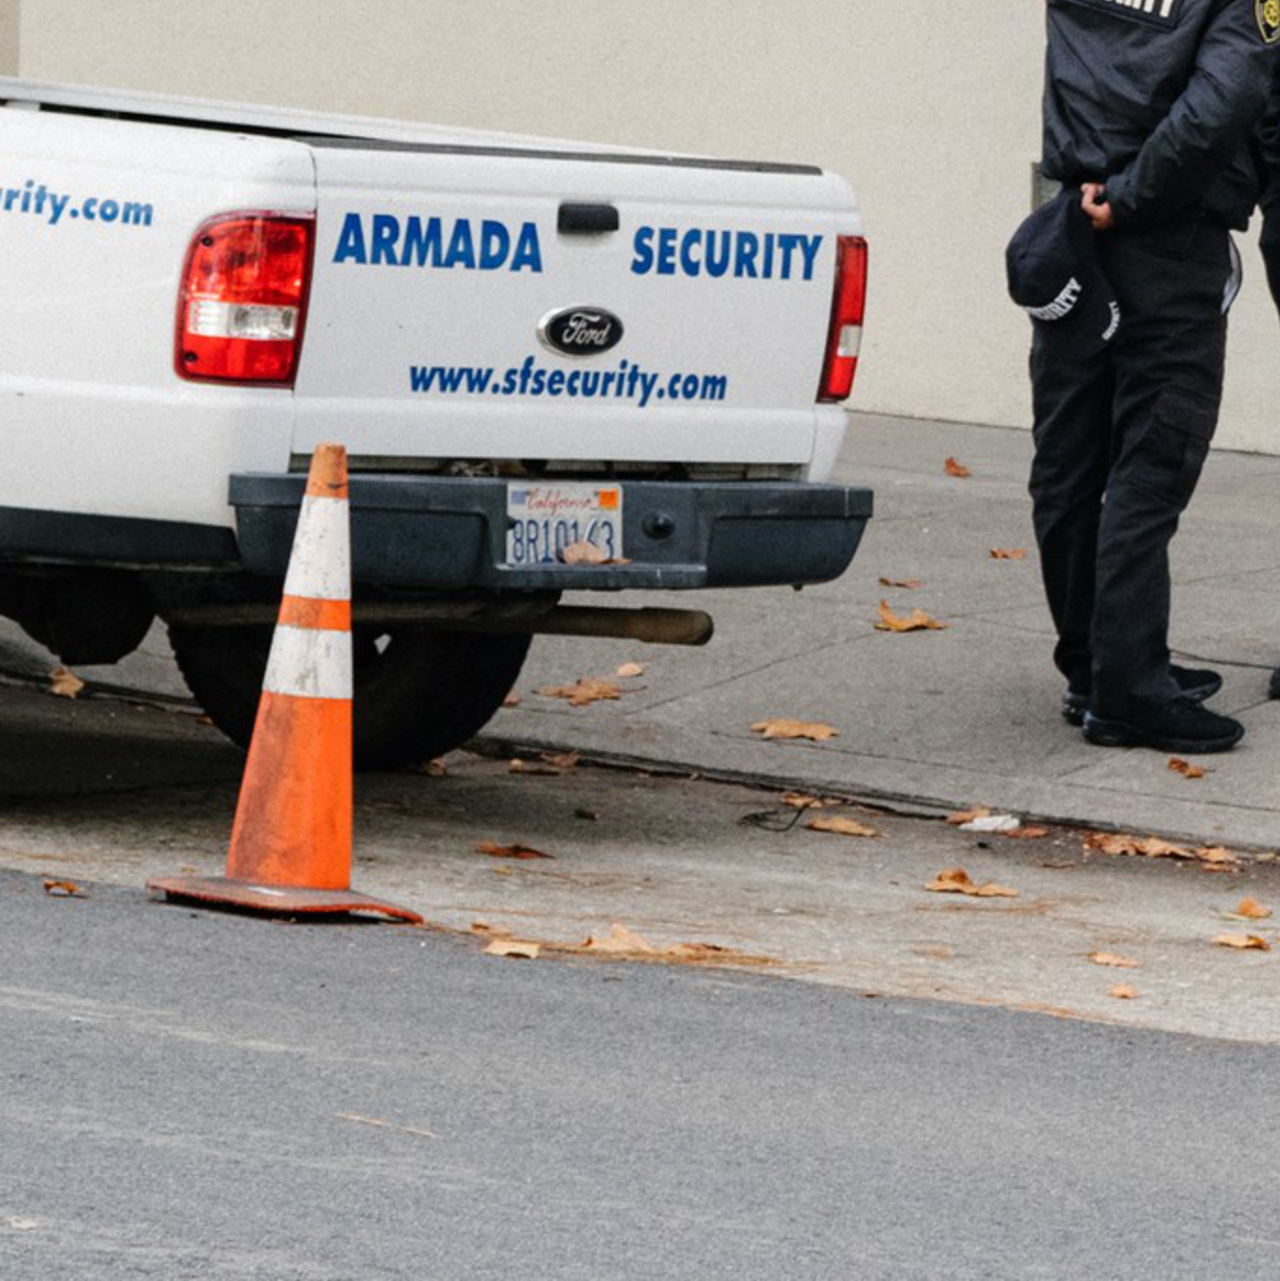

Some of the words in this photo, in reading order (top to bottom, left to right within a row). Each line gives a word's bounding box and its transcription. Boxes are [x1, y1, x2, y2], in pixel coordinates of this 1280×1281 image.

[0, 179, 154, 226] rity.com
[331, 212, 543, 273] ARMADA
[630, 225, 824, 281] SECURITY
[562, 312, 612, 345] Ford
[409, 355, 728, 407] www.sfsecurity.com
